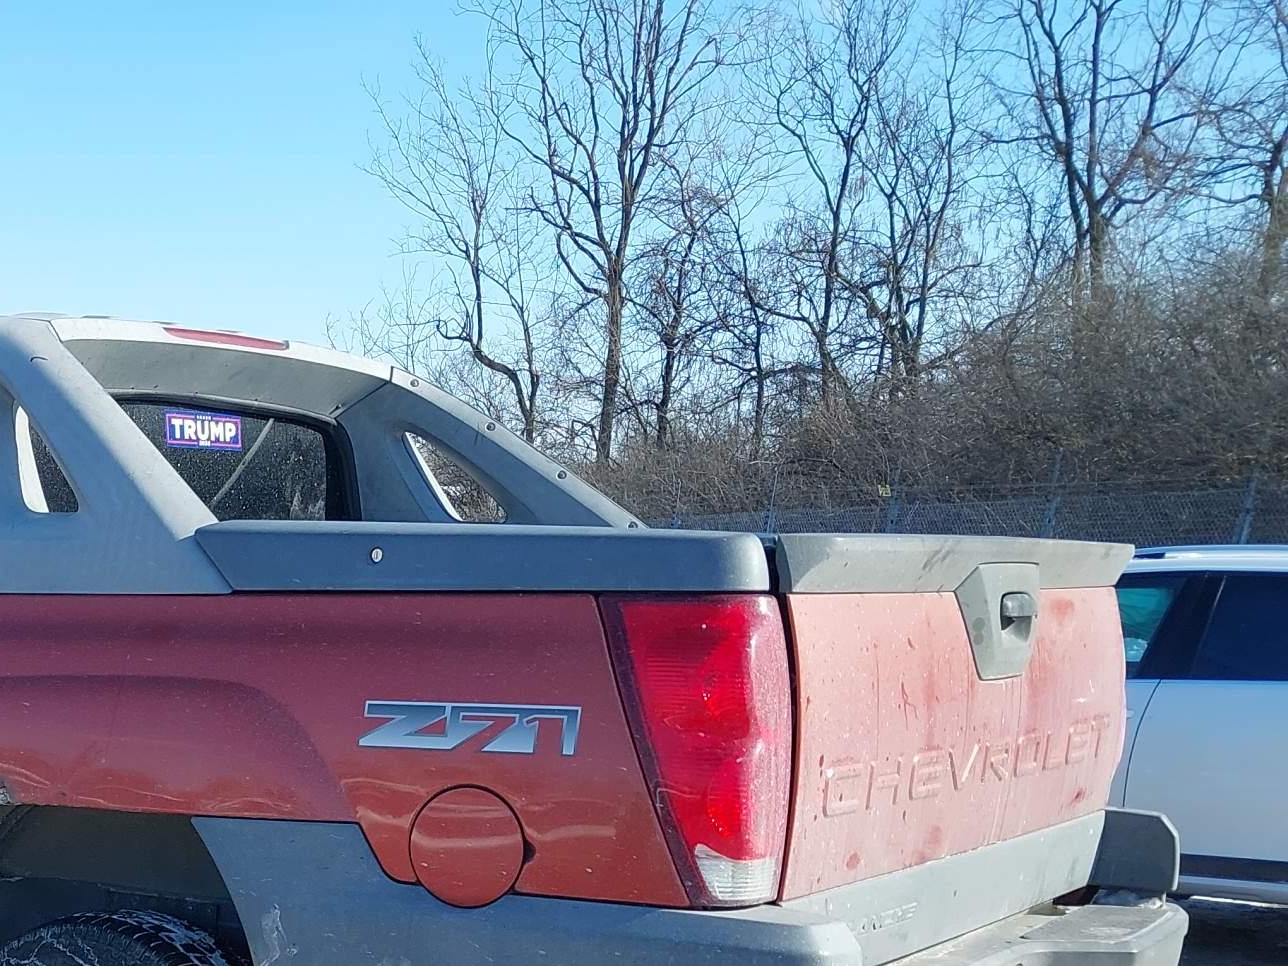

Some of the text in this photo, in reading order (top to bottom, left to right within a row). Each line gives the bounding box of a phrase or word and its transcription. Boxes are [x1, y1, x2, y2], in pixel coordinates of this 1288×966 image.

[171, 418, 236, 442] TRUMP
[358, 700, 581, 755] Z71
[822, 714, 1110, 818] CHEVROLET
